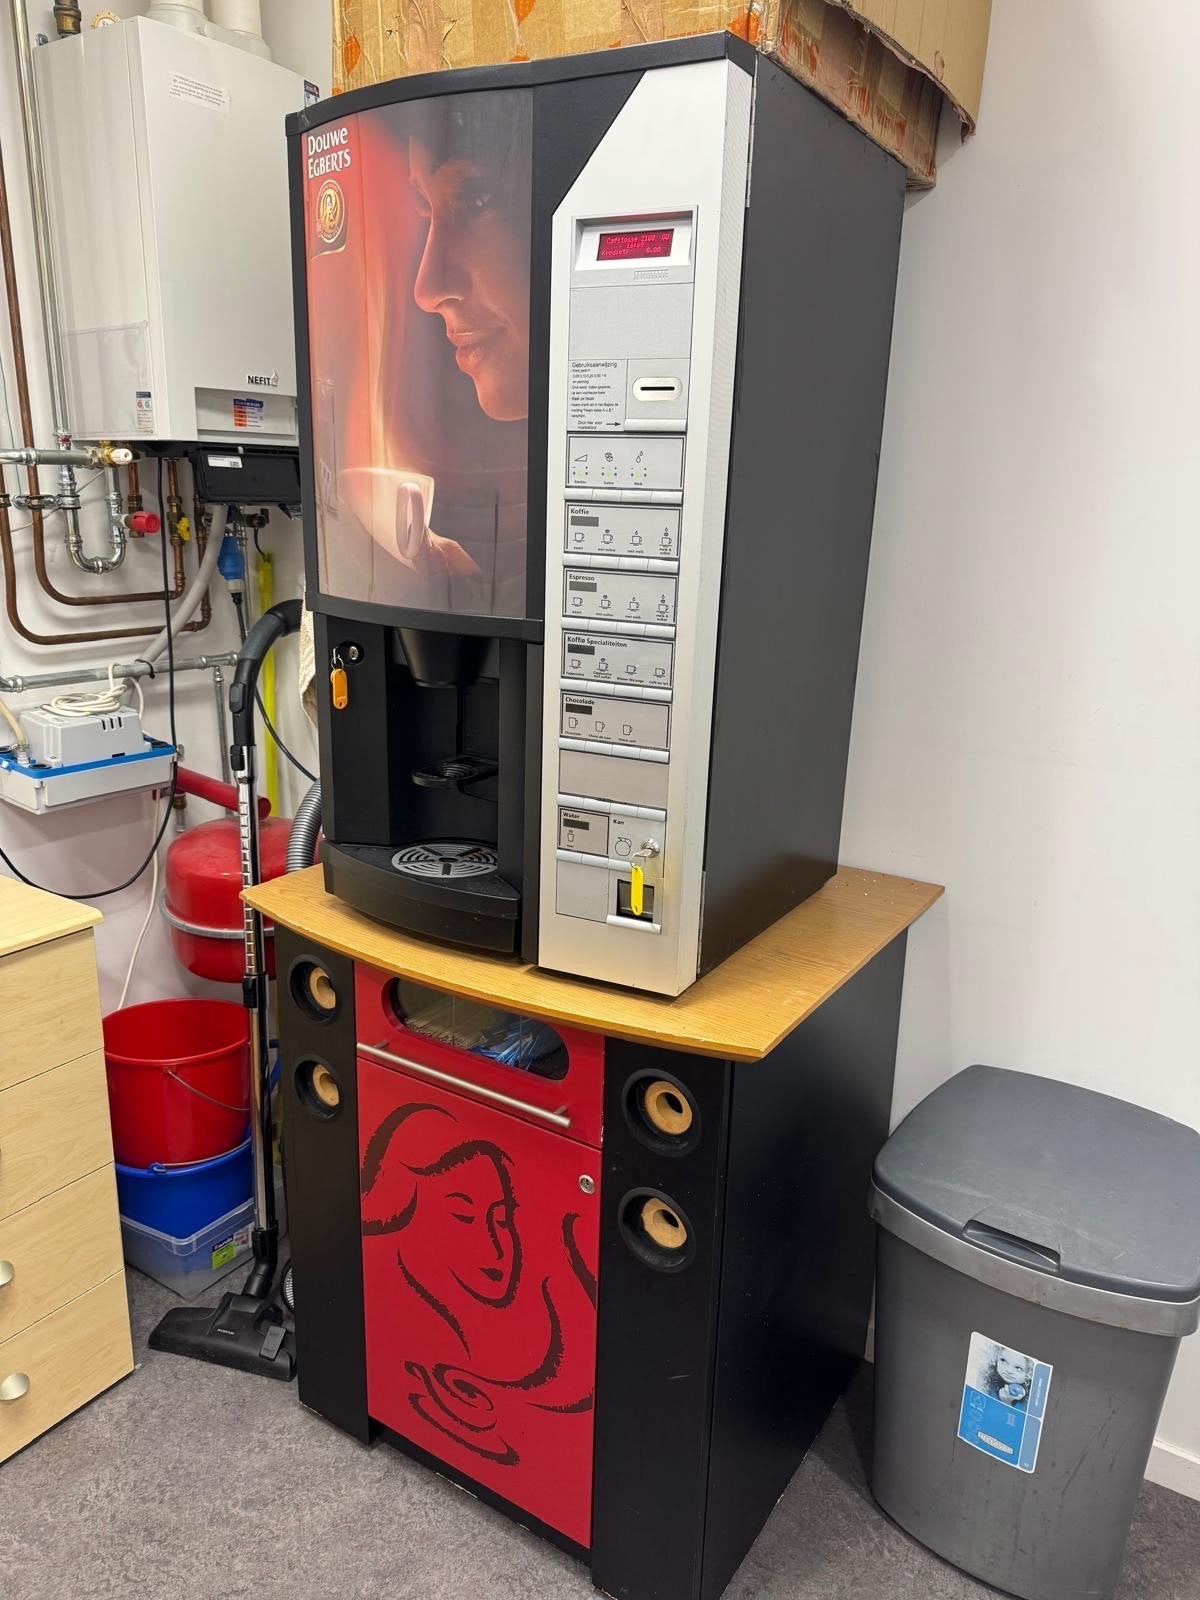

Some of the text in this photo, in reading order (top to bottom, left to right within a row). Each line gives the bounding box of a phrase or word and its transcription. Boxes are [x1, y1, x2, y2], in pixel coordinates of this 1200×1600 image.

[308, 128, 348, 156] Douwe
[308, 149, 351, 179] EGBERTS
[247, 375, 271, 386] NEFIT
[569, 573, 595, 582] Espresso
[586, 638, 627, 648] Specialiteiten
[565, 697, 595, 705] Chocolade
